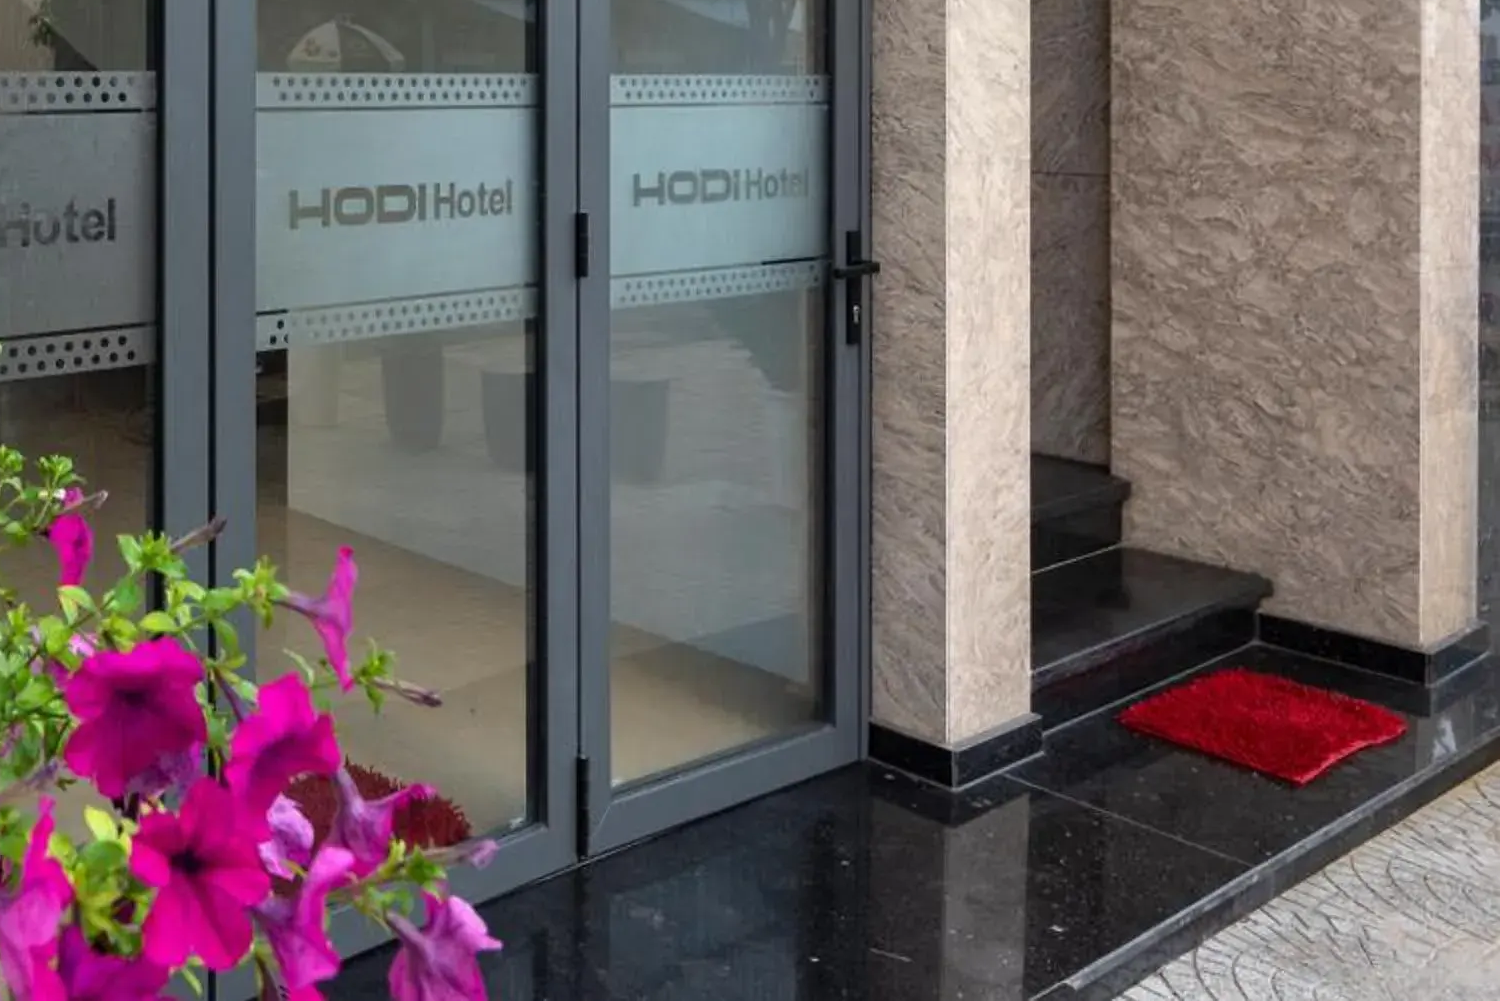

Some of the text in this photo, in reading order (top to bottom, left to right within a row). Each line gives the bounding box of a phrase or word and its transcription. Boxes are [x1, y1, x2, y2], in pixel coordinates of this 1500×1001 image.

[289, 179, 514, 230] HODI Hotel
[633, 166, 810, 207] HODI Hotel
[2, 198, 116, 248] Hotel
